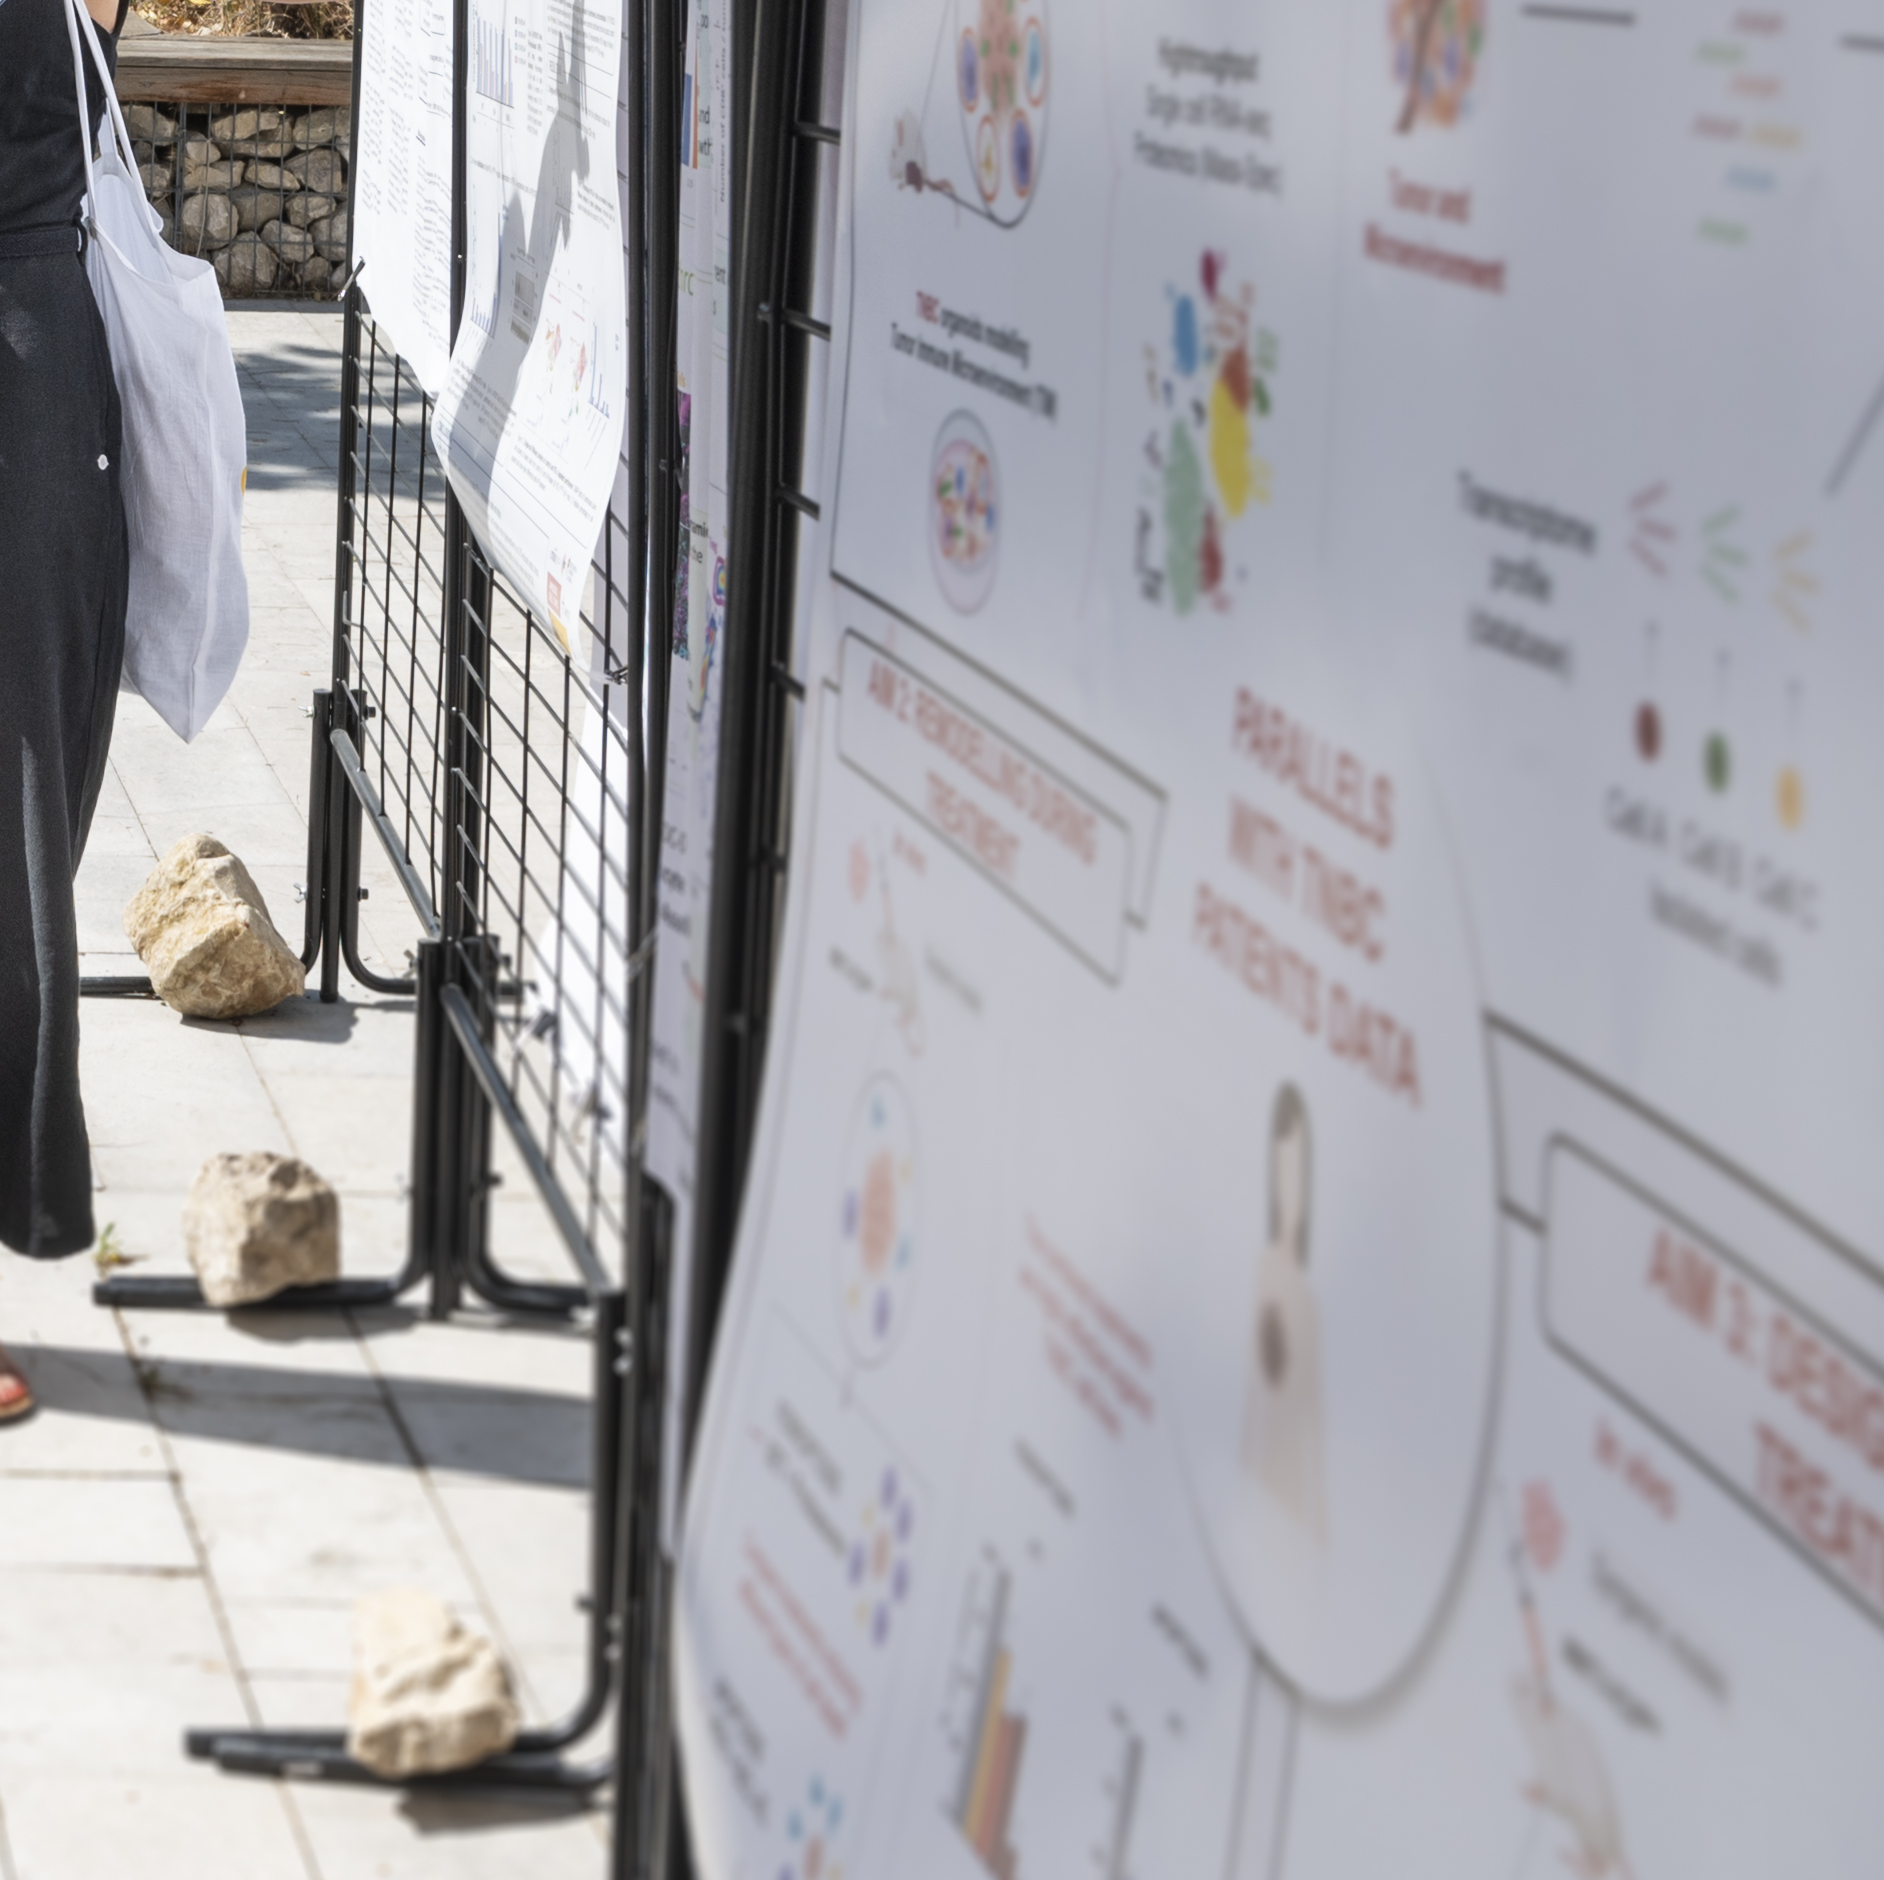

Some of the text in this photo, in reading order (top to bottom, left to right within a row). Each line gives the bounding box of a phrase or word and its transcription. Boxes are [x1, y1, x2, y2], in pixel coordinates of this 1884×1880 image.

[1228, 791, 1293, 905] WITH
[1232, 684, 1394, 851] PARALLELS
[1192, 881, 1424, 1111] PATIENTS DATA
